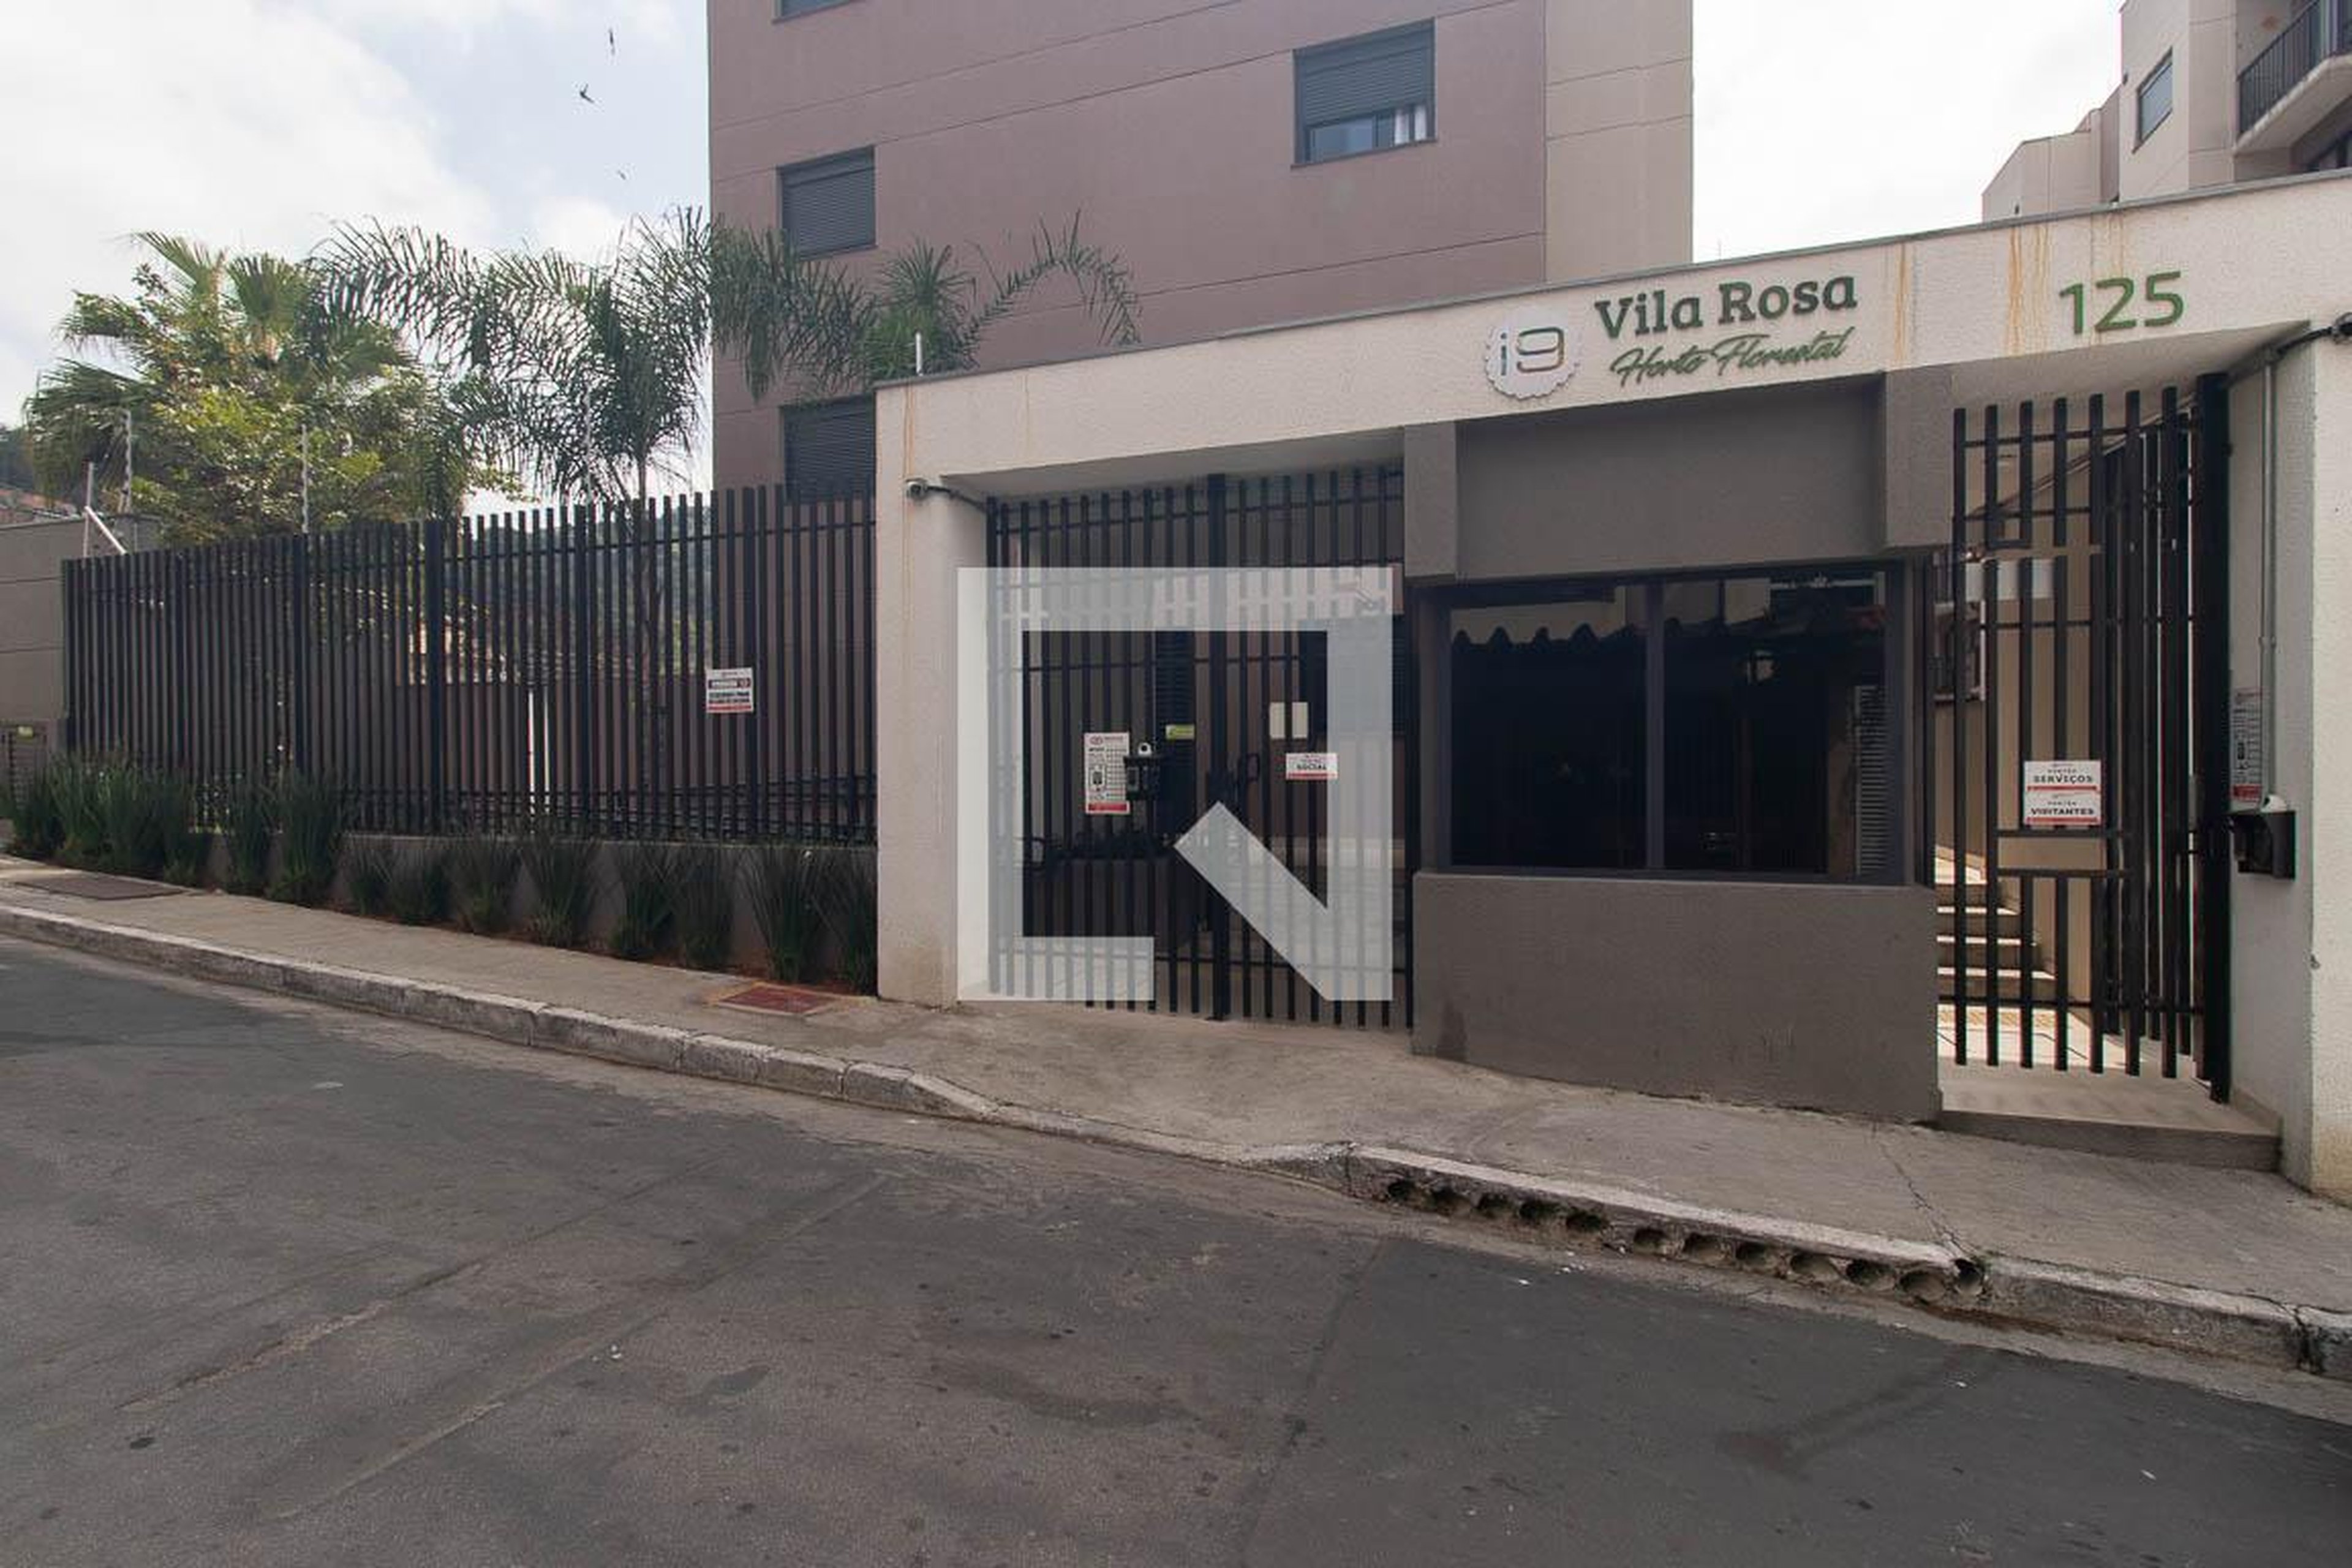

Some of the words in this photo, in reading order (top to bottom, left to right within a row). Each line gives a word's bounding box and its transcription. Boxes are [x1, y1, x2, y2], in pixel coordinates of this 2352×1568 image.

[1594, 290, 1704, 339] Vila
[1717, 276, 1858, 324] Rosa
[2059, 270, 2184, 334] 125
[1610, 345, 1709, 386] Horto
[2033, 775, 2093, 784] SERVIÇOS
